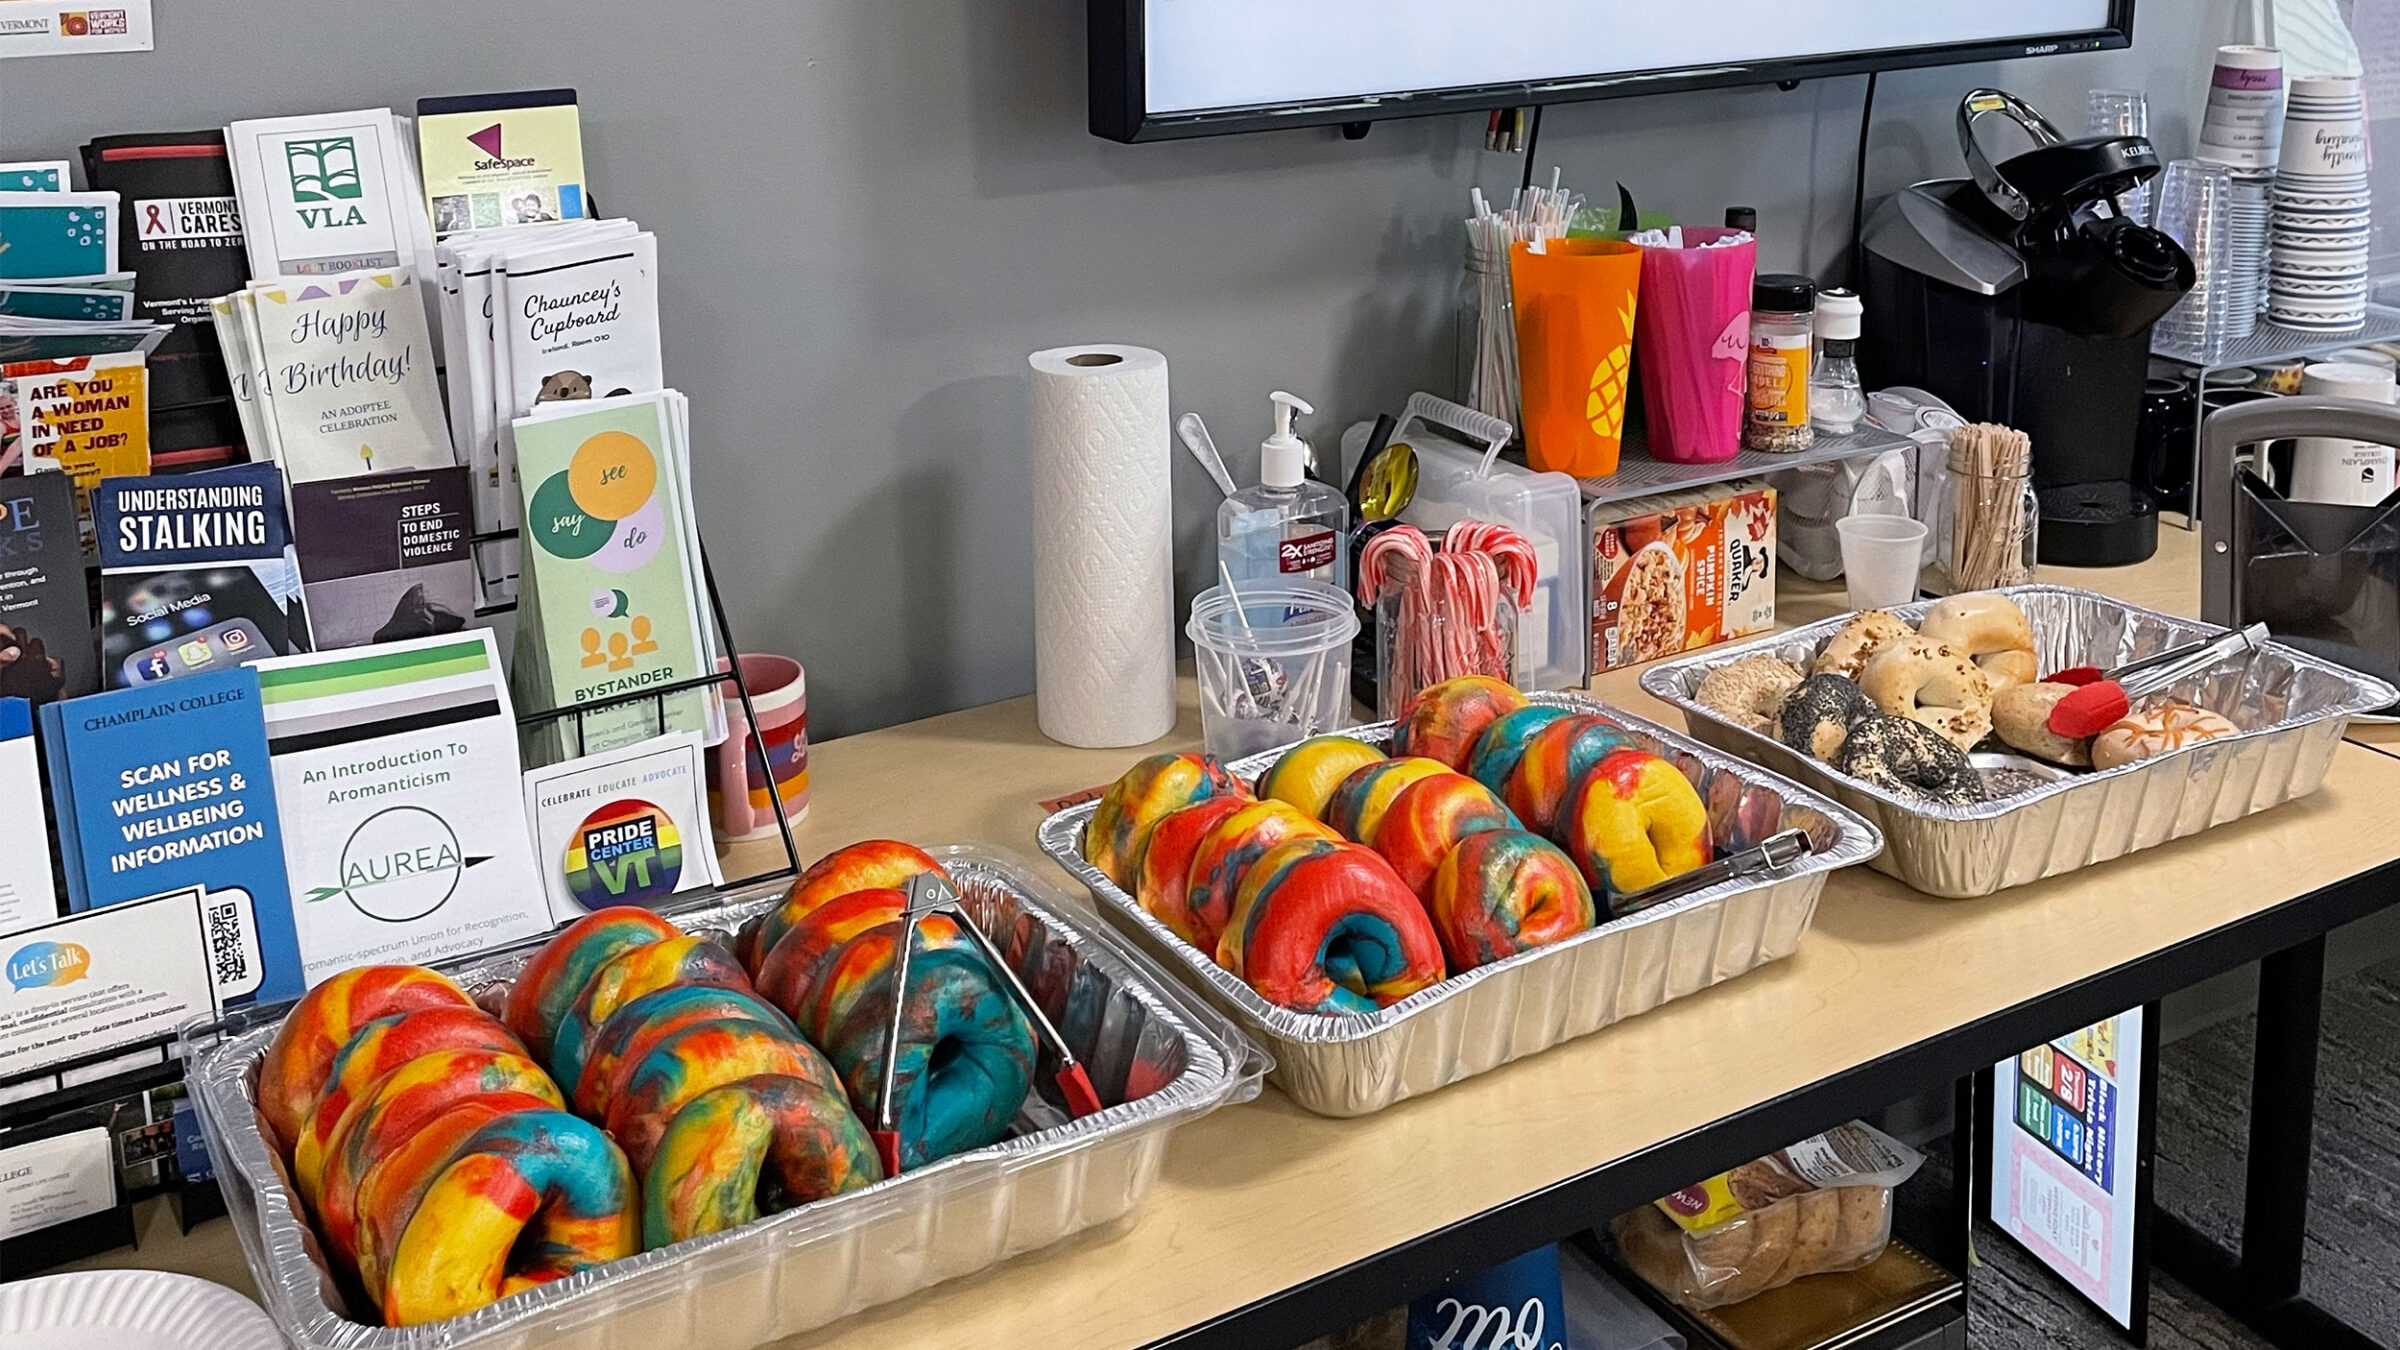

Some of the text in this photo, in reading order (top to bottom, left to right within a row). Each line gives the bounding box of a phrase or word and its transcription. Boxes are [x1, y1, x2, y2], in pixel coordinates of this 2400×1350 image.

[0, 19, 49, 31] VERMONT
[91, 19, 125, 29] WORKS
[2025, 44, 2058, 55] SHARP
[178, 200, 238, 216] VERMONT
[296, 205, 367, 229] VLA
[181, 213, 242, 235] CARES
[142, 237, 244, 251] ON THE ROAD TO ZER
[523, 279, 621, 319] Chauncey's
[290, 309, 389, 344] Happy
[530, 303, 621, 342] Cupboard
[571, 338, 593, 349] Room
[280, 344, 412, 394] Birthday!
[30, 379, 114, 401] ARE YOU
[31, 395, 130, 420] A WOMAN
[320, 400, 392, 421] AN ADOPTEE
[32, 417, 105, 438] IN NEED
[319, 413, 398, 434] CELEBRATION
[33, 433, 128, 458] OF A JOB?
[600, 465, 628, 486] see
[118, 485, 263, 512] UNDERSTANDING
[401, 502, 441, 519] STEPS
[119, 510, 266, 552] STALKING
[402, 519, 443, 534] TO END
[403, 529, 460, 546] DOMESTIC
[551, 514, 586, 537] say
[623, 527, 648, 549] do
[403, 542, 453, 558] VIOLENCE
[1281, 543, 1303, 560] 2X
[4, 567, 38, 579] through
[1696, 559, 1706, 597] SPICE
[1705, 544, 1716, 607] PUMPKIN
[1728, 538, 1744, 602] QUAKER
[0, 575, 47, 591] ention, and
[2, 599, 39, 612] Vermont
[126, 593, 212, 627] Social Media
[574, 667, 673, 702] BYSTANDER
[83, 688, 246, 732] CHAMPLAIN COLLEGE
[120, 749, 231, 789] SCAN FOR
[303, 743, 468, 784] An Introduction To
[642, 765, 687, 784] ADVOCATE
[112, 773, 247, 818] WELLNESS &
[327, 770, 451, 805] Aromanticism
[541, 787, 591, 808] CELEBRATE
[597, 777, 637, 795] EDUCATE
[121, 800, 245, 843] WELLBEING
[110, 821, 264, 873] INFORMATION
[588, 820, 654, 850] PRIDE
[590, 836, 655, 862] CENTER
[345, 843, 460, 889] AUREA
[592, 847, 656, 895] VT
[303, 910, 529, 972] romantic-spectrum Union for Recognition,
[410, 936, 484, 963] and Advocacy
[12, 948, 83, 981] Let's Talk
[107, 983, 130, 994] offers
[17, 1045, 30, 1054] for
[31, 1042, 45, 1050] the
[134, 1012, 149, 1022] and
[2060, 1064, 2073, 1102] 2/8
[2086, 1077, 2097, 1124] Trivia
[2094, 1077, 2109, 1187] Black History
[2083, 1126, 2095, 1172] Night
[1671, 1189, 1704, 1211] NEW
